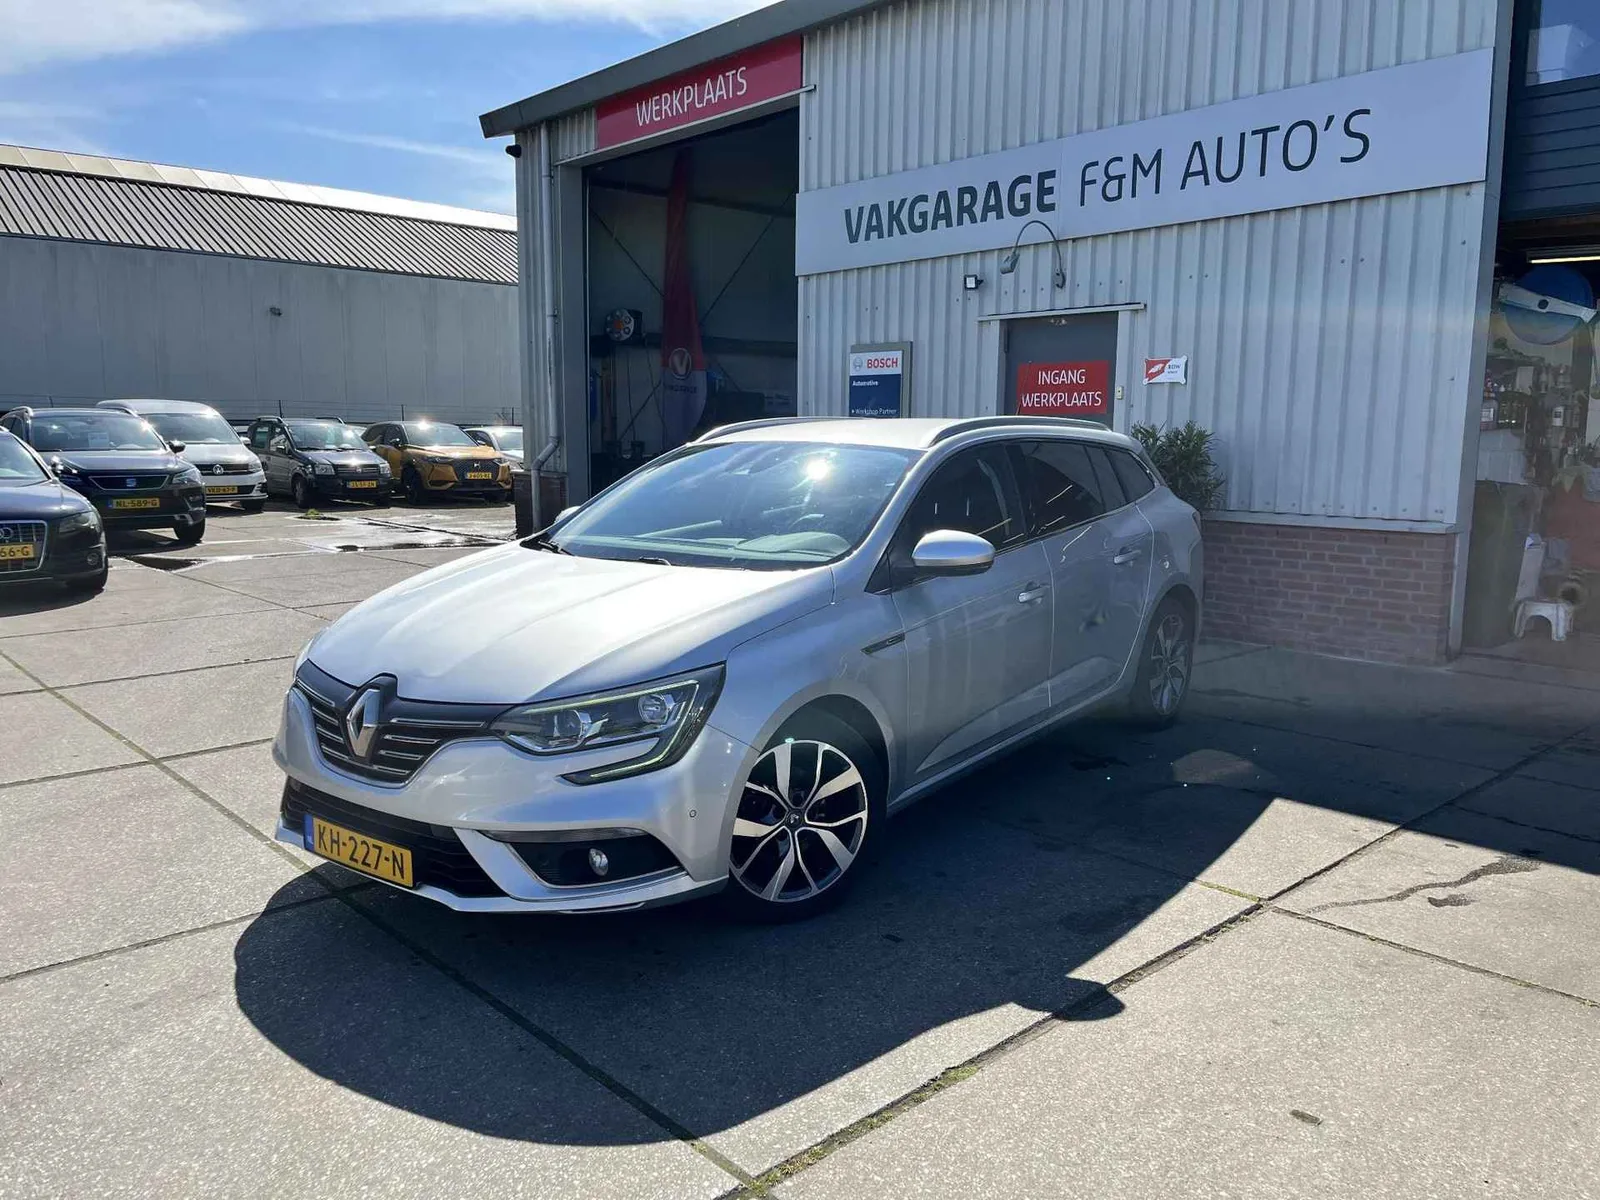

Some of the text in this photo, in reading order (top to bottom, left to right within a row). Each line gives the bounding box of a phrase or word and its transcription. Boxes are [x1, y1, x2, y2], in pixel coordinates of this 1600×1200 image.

[636, 66, 747, 127] WERKPLAATS
[844, 108, 1371, 244] VAKGARAGE F&M AUTO'S
[867, 357, 898, 369] BOSCH
[1038, 369, 1086, 385] INGANG
[1022, 391, 1102, 408] WERKPLAATS
[116, 500, 158, 508] NL-589-G
[318, 824, 405, 880] KH-227-N
